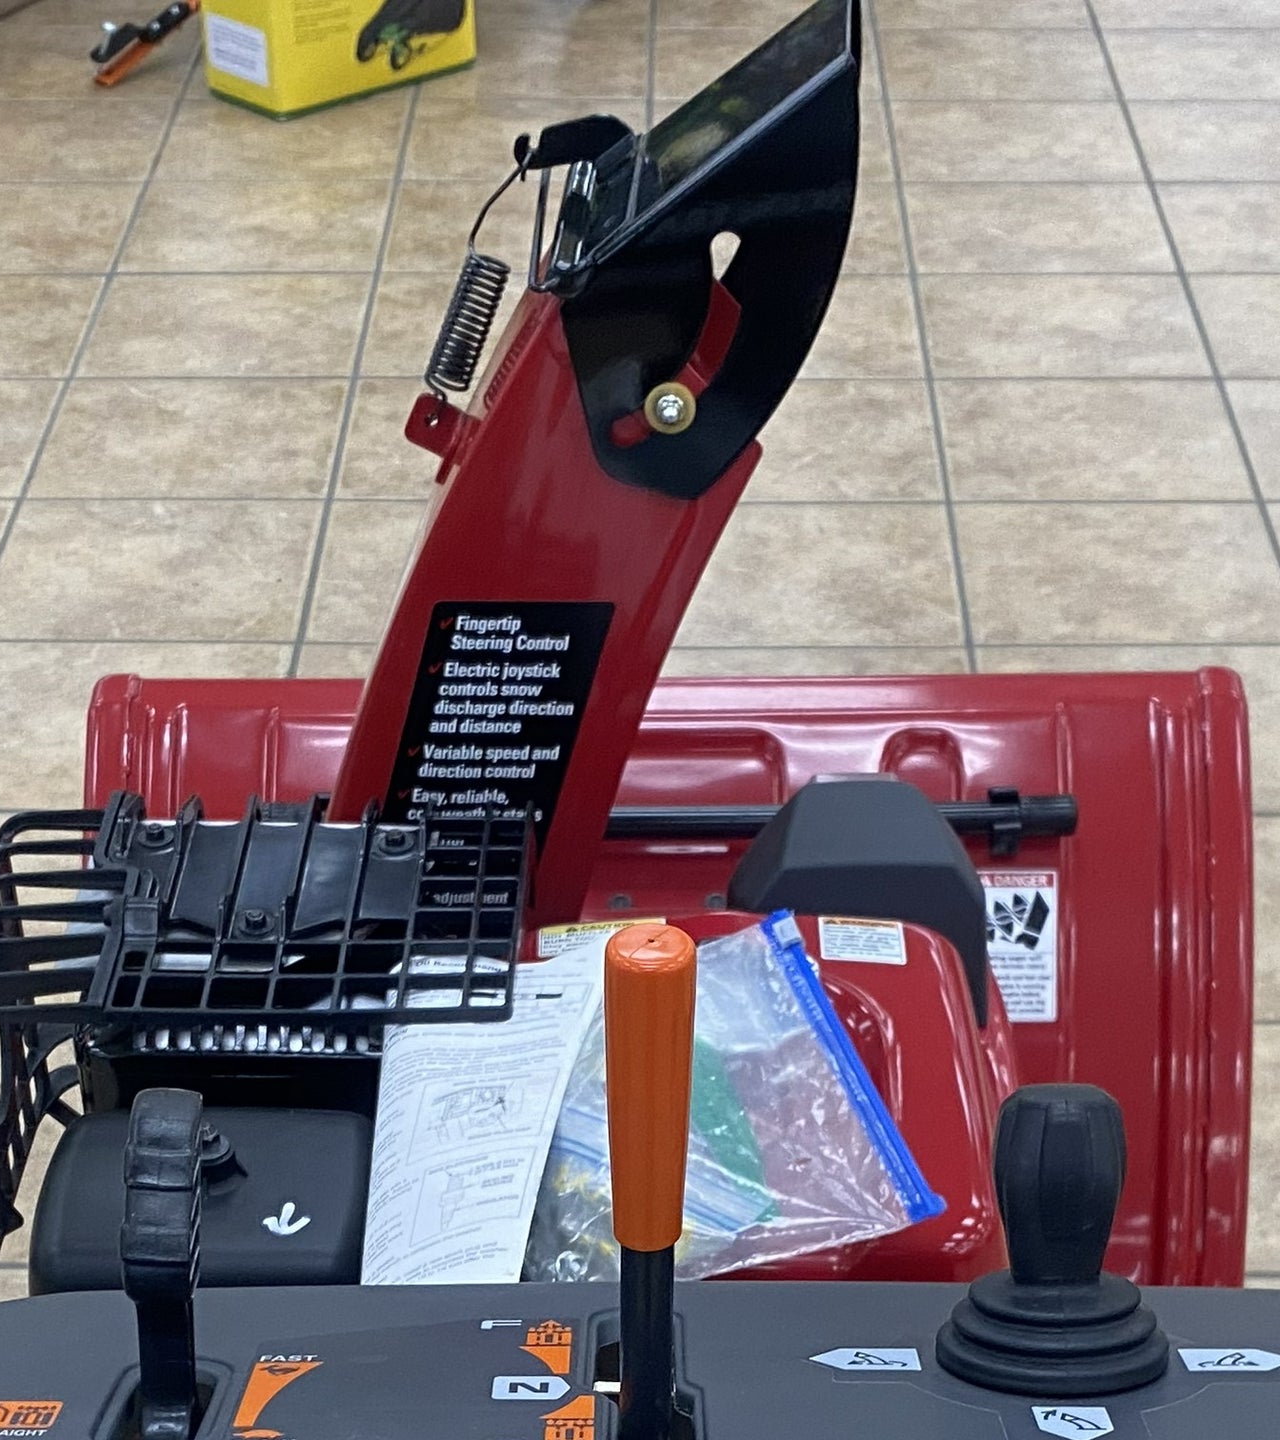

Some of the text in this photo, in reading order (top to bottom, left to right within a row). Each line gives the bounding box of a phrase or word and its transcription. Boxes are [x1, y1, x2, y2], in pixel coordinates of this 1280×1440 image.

[455, 615, 521, 635] Fingertip
[450, 635, 569, 653] Steering Control
[443, 662, 560, 680] Electric joystick
[439, 682, 542, 696] controls snow
[434, 700, 574, 718] discharge direction
[429, 719, 521, 733] and distance
[423, 745, 560, 763] Variable speed and
[418, 764, 535, 778] direction control
[411, 788, 509, 805] Easy, reliable,
[432, 891, 509, 906] adjustent
[509, 1382, 549, 1394] N
